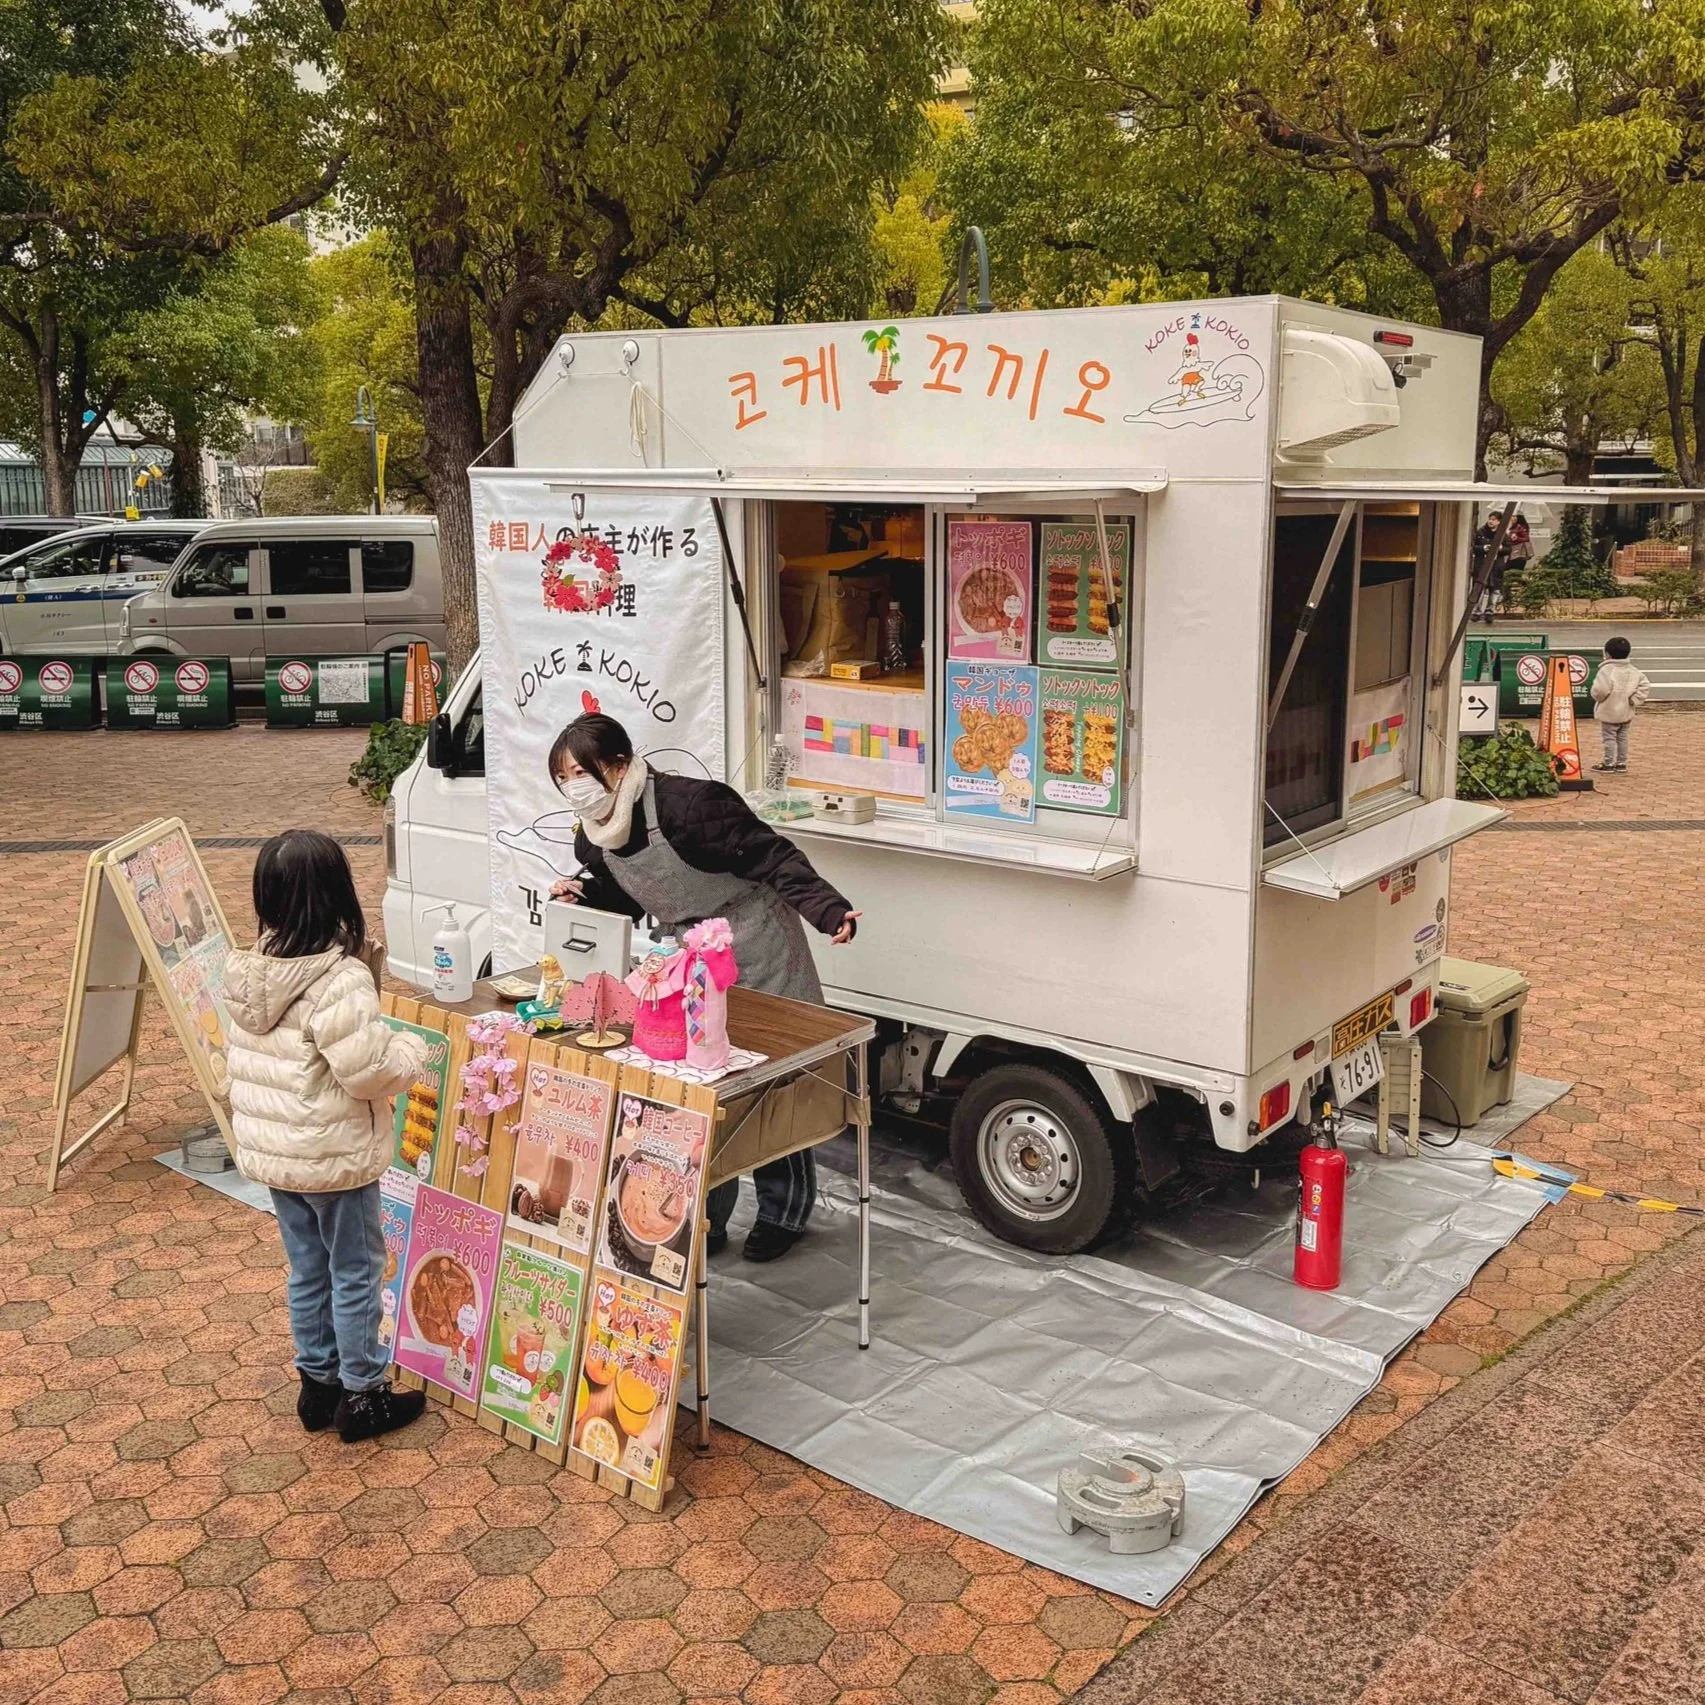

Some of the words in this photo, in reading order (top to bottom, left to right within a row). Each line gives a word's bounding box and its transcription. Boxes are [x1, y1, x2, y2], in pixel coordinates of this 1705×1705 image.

[1144, 316, 1185, 354] KOKE
[1204, 316, 1250, 352] KOKIO
[729, 343, 842, 430] 코케
[922, 333, 1111, 424] 꼬끼오
[955, 526, 1027, 550] トッポギ
[990, 551, 1026, 572] ¥600
[423, 664, 430, 680] NO
[514, 647, 568, 716] KOKE
[598, 647, 678, 724] KOKIO
[952, 676, 1033, 697] マンドゥ
[994, 697, 1034, 717] ¥600
[1560, 696, 1572, 744] 駐輪禁止
[1335, 997, 1393, 1053] 高圧ガス
[533, 1073, 547, 1085] Hot
[548, 1088, 604, 1120] ユルム茶
[625, 1102, 640, 1115] Hot
[641, 1105, 705, 1142] 韓国コーヒー
[565, 1134, 600, 1163] ¥400
[659, 1167, 696, 1199] ¥350
[420, 1191, 498, 1244] トッポギ
[453, 1238, 490, 1276] ¥600
[503, 1257, 577, 1301] フルーツサイダー
[599, 1287, 614, 1302] Hot
[539, 1295, 573, 1329] ¥500
[615, 1304, 676, 1352] ゆず茶
[632, 1356, 673, 1394] ¥400
